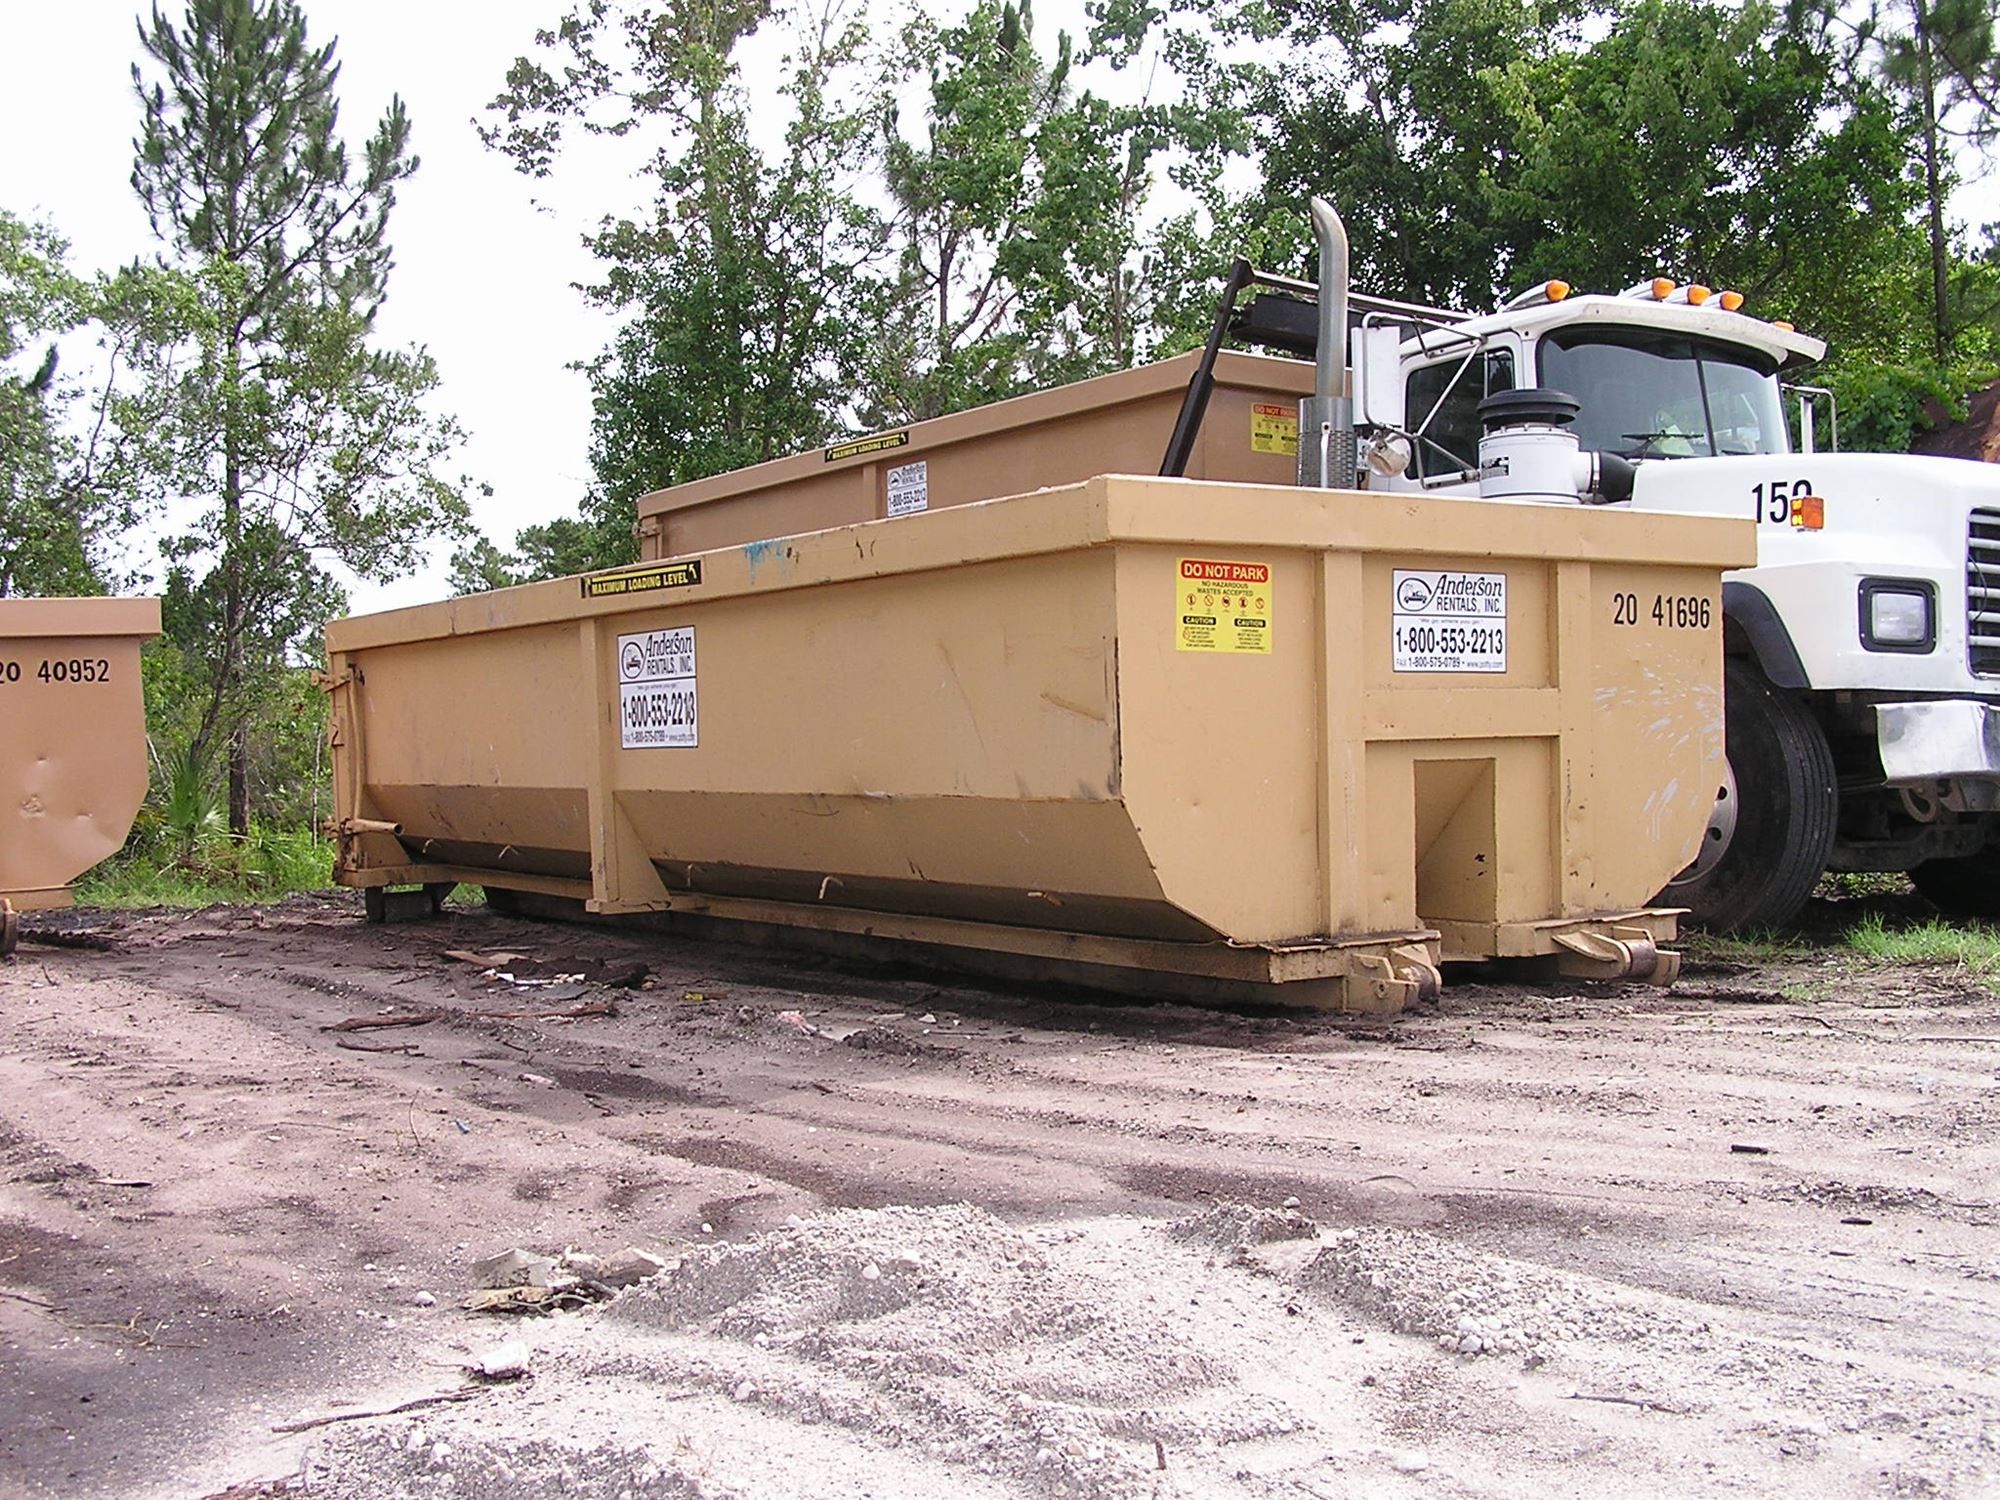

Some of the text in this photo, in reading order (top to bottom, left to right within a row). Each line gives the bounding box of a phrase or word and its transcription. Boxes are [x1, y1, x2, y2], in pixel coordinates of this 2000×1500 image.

[591, 571, 688, 595] MAXIMUM LOADING LEVEL
[1184, 563, 1265, 581] DO NOT PARK
[1197, 587, 1254, 597] WASTES ACCEPTED
[1212, 581, 1249, 589] HAZARDOUS
[1435, 574, 1503, 597] Anderson
[1436, 596, 1502, 613] RENTALS, INC.
[1613, 592, 1710, 629] 20 41696
[1185, 617, 1214, 625] CAUTION
[1237, 619, 1264, 627] CAUTION
[644, 632, 693, 658] Anderson
[1396, 626, 1503, 654] 1-800-553-2213
[37, 659, 109, 683] 40952
[623, 691, 695, 728] 1-800-553-2213
